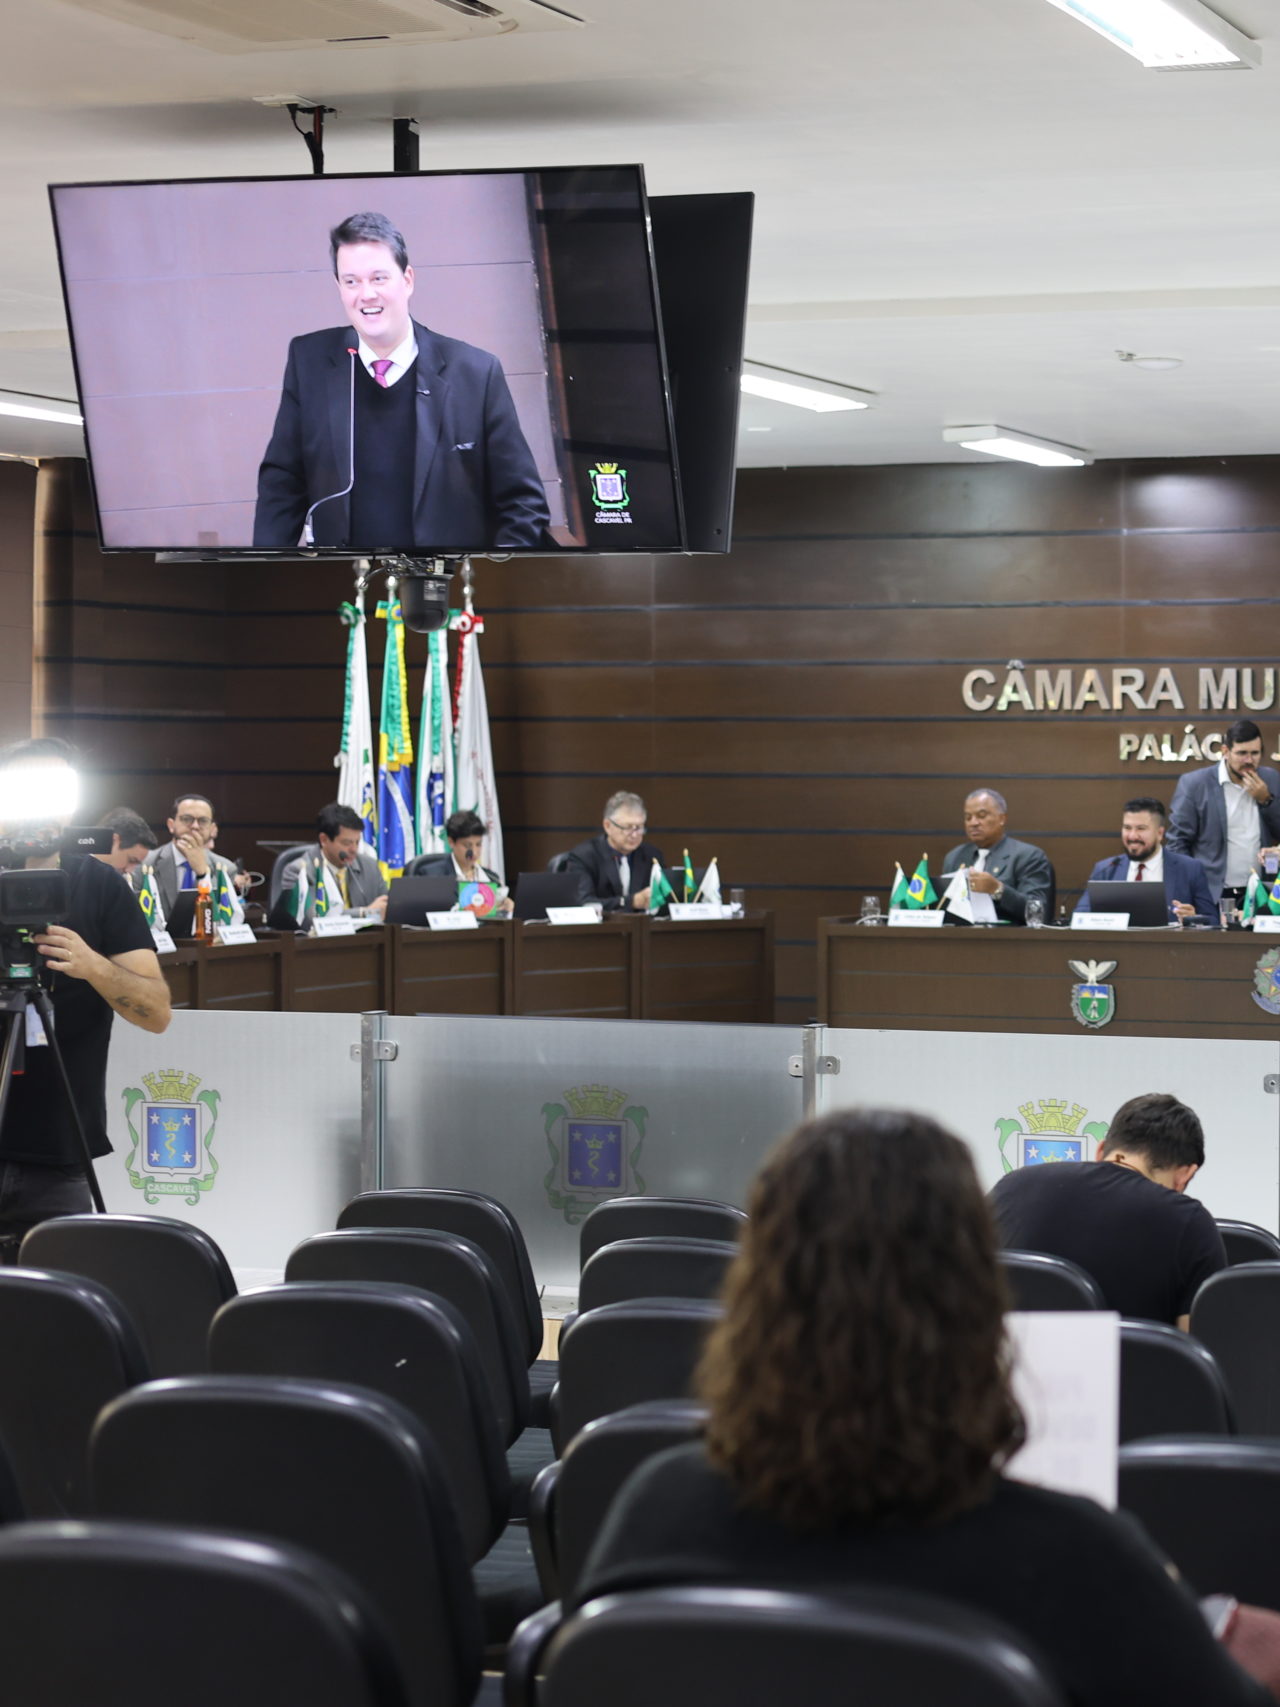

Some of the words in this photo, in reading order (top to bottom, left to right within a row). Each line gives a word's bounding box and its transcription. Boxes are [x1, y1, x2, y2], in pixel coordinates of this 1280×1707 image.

[962, 659, 1185, 711] CÂMARA
[1119, 724, 1229, 762] PALÁC
[146, 1183, 196, 1194] CASCAVEL
